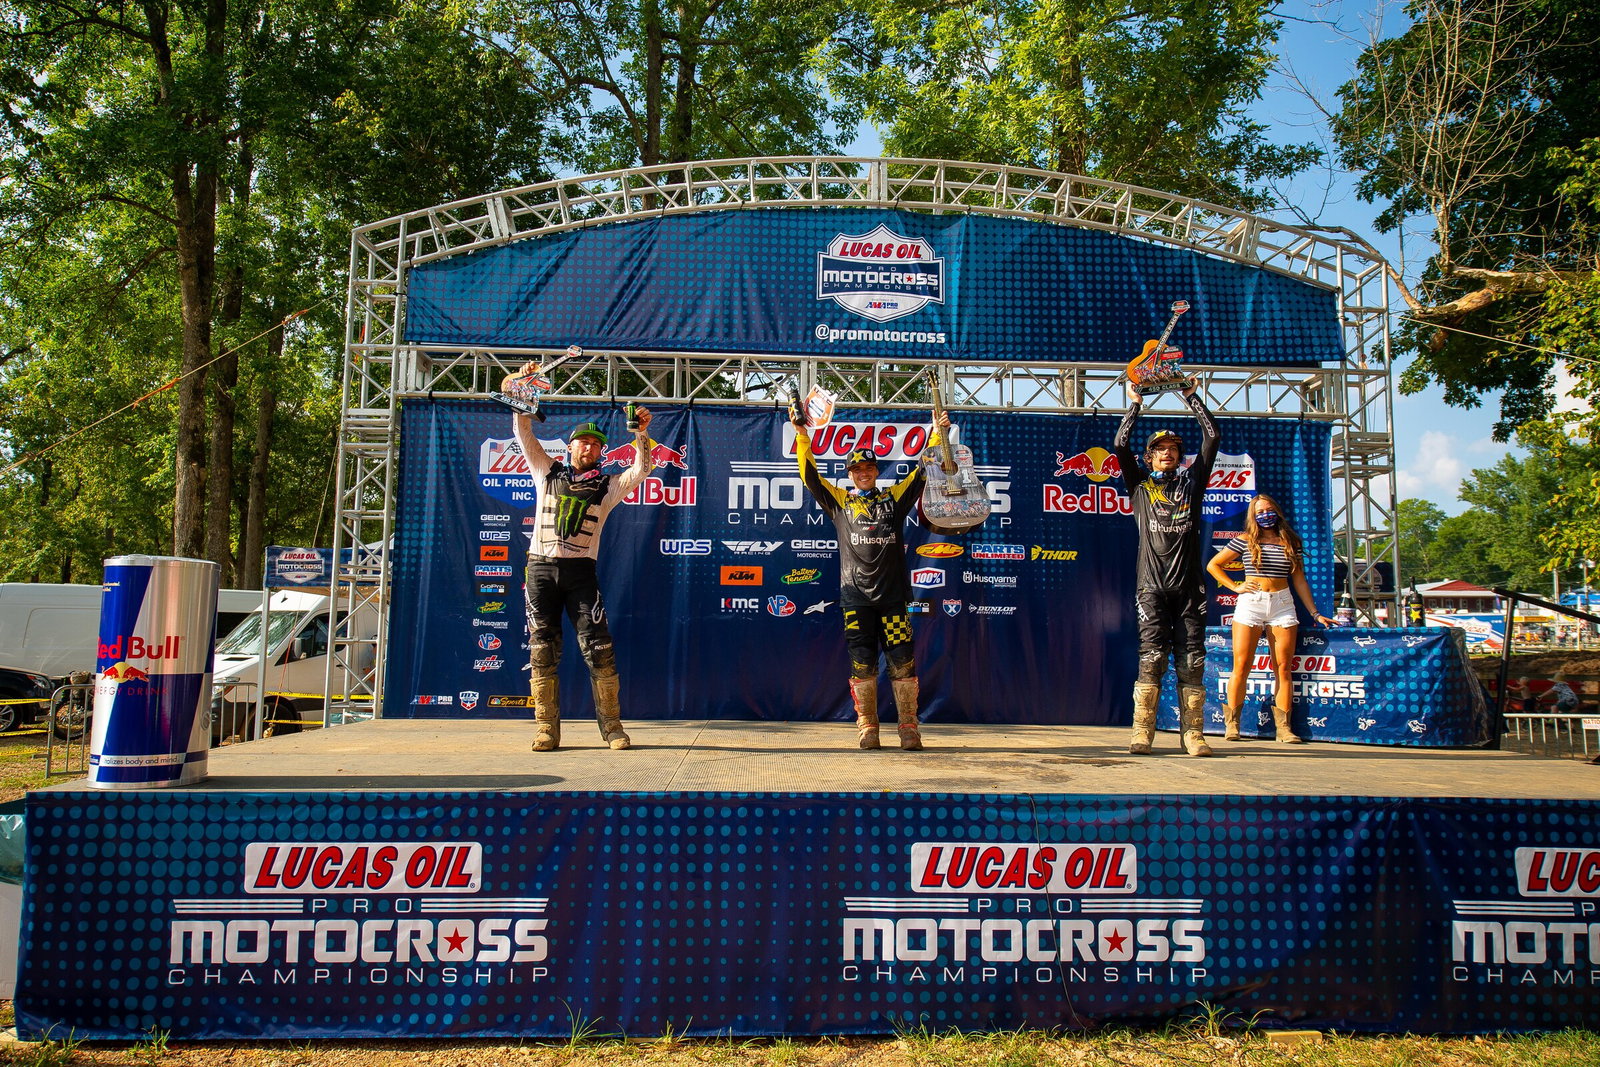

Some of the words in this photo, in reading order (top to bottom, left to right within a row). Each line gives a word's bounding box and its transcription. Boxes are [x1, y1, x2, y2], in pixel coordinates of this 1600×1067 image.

[839, 242, 893, 258] LUCAS
[897, 243, 922, 259] OIL
[823, 270, 938, 286] MOTOCROSS
[823, 283, 939, 291] CHAMPIONSHIP
[815, 324, 946, 344] @promotocross
[790, 425, 897, 456] UCAS
[483, 479, 501, 487] OIL
[505, 479, 534, 487] PROD
[1206, 470, 1251, 488] CAS
[512, 492, 534, 500] INC.
[644, 477, 696, 505] Bull
[1044, 485, 1096, 512] Red
[1100, 487, 1133, 514] Bu
[1203, 494, 1252, 502] RODUCTS
[1202, 506, 1224, 514] INC.
[480, 531, 510, 541] WPS
[660, 539, 711, 555] WPS
[721, 541, 784, 551] FLY
[791, 540, 838, 549] GEICO
[920, 545, 964, 555] FMF
[972, 544, 1024, 553] PARTS
[1042, 550, 1078, 560] THOR
[728, 571, 755, 580] KTM
[792, 568, 817, 576] Battery
[916, 573, 940, 583] 100%
[785, 575, 813, 584] Tender
[973, 574, 1017, 584] Husqvarna
[769, 595, 788, 615] VP
[480, 633, 495, 649] VP
[128, 636, 180, 659] Bull
[1304, 656, 1331, 671] OIL
[128, 687, 168, 696] DRINK
[410, 695, 437, 705] AMA
[500, 697, 524, 706] Sports
[126, 757, 143, 765] body
[254, 845, 399, 889] LUCAS
[404, 845, 474, 889] OIL
[920, 846, 1057, 889] LUCAS
[1064, 848, 1129, 889] OIL
[313, 899, 412, 913] PRO
[978, 899, 1073, 913] PRO
[169, 918, 549, 964] MOTOCROSS
[843, 918, 1205, 962] MOTOCROSS
[168, 967, 548, 984] CHAMPIONSHIP
[843, 966, 1207, 982] CHAMPIONSHIP
